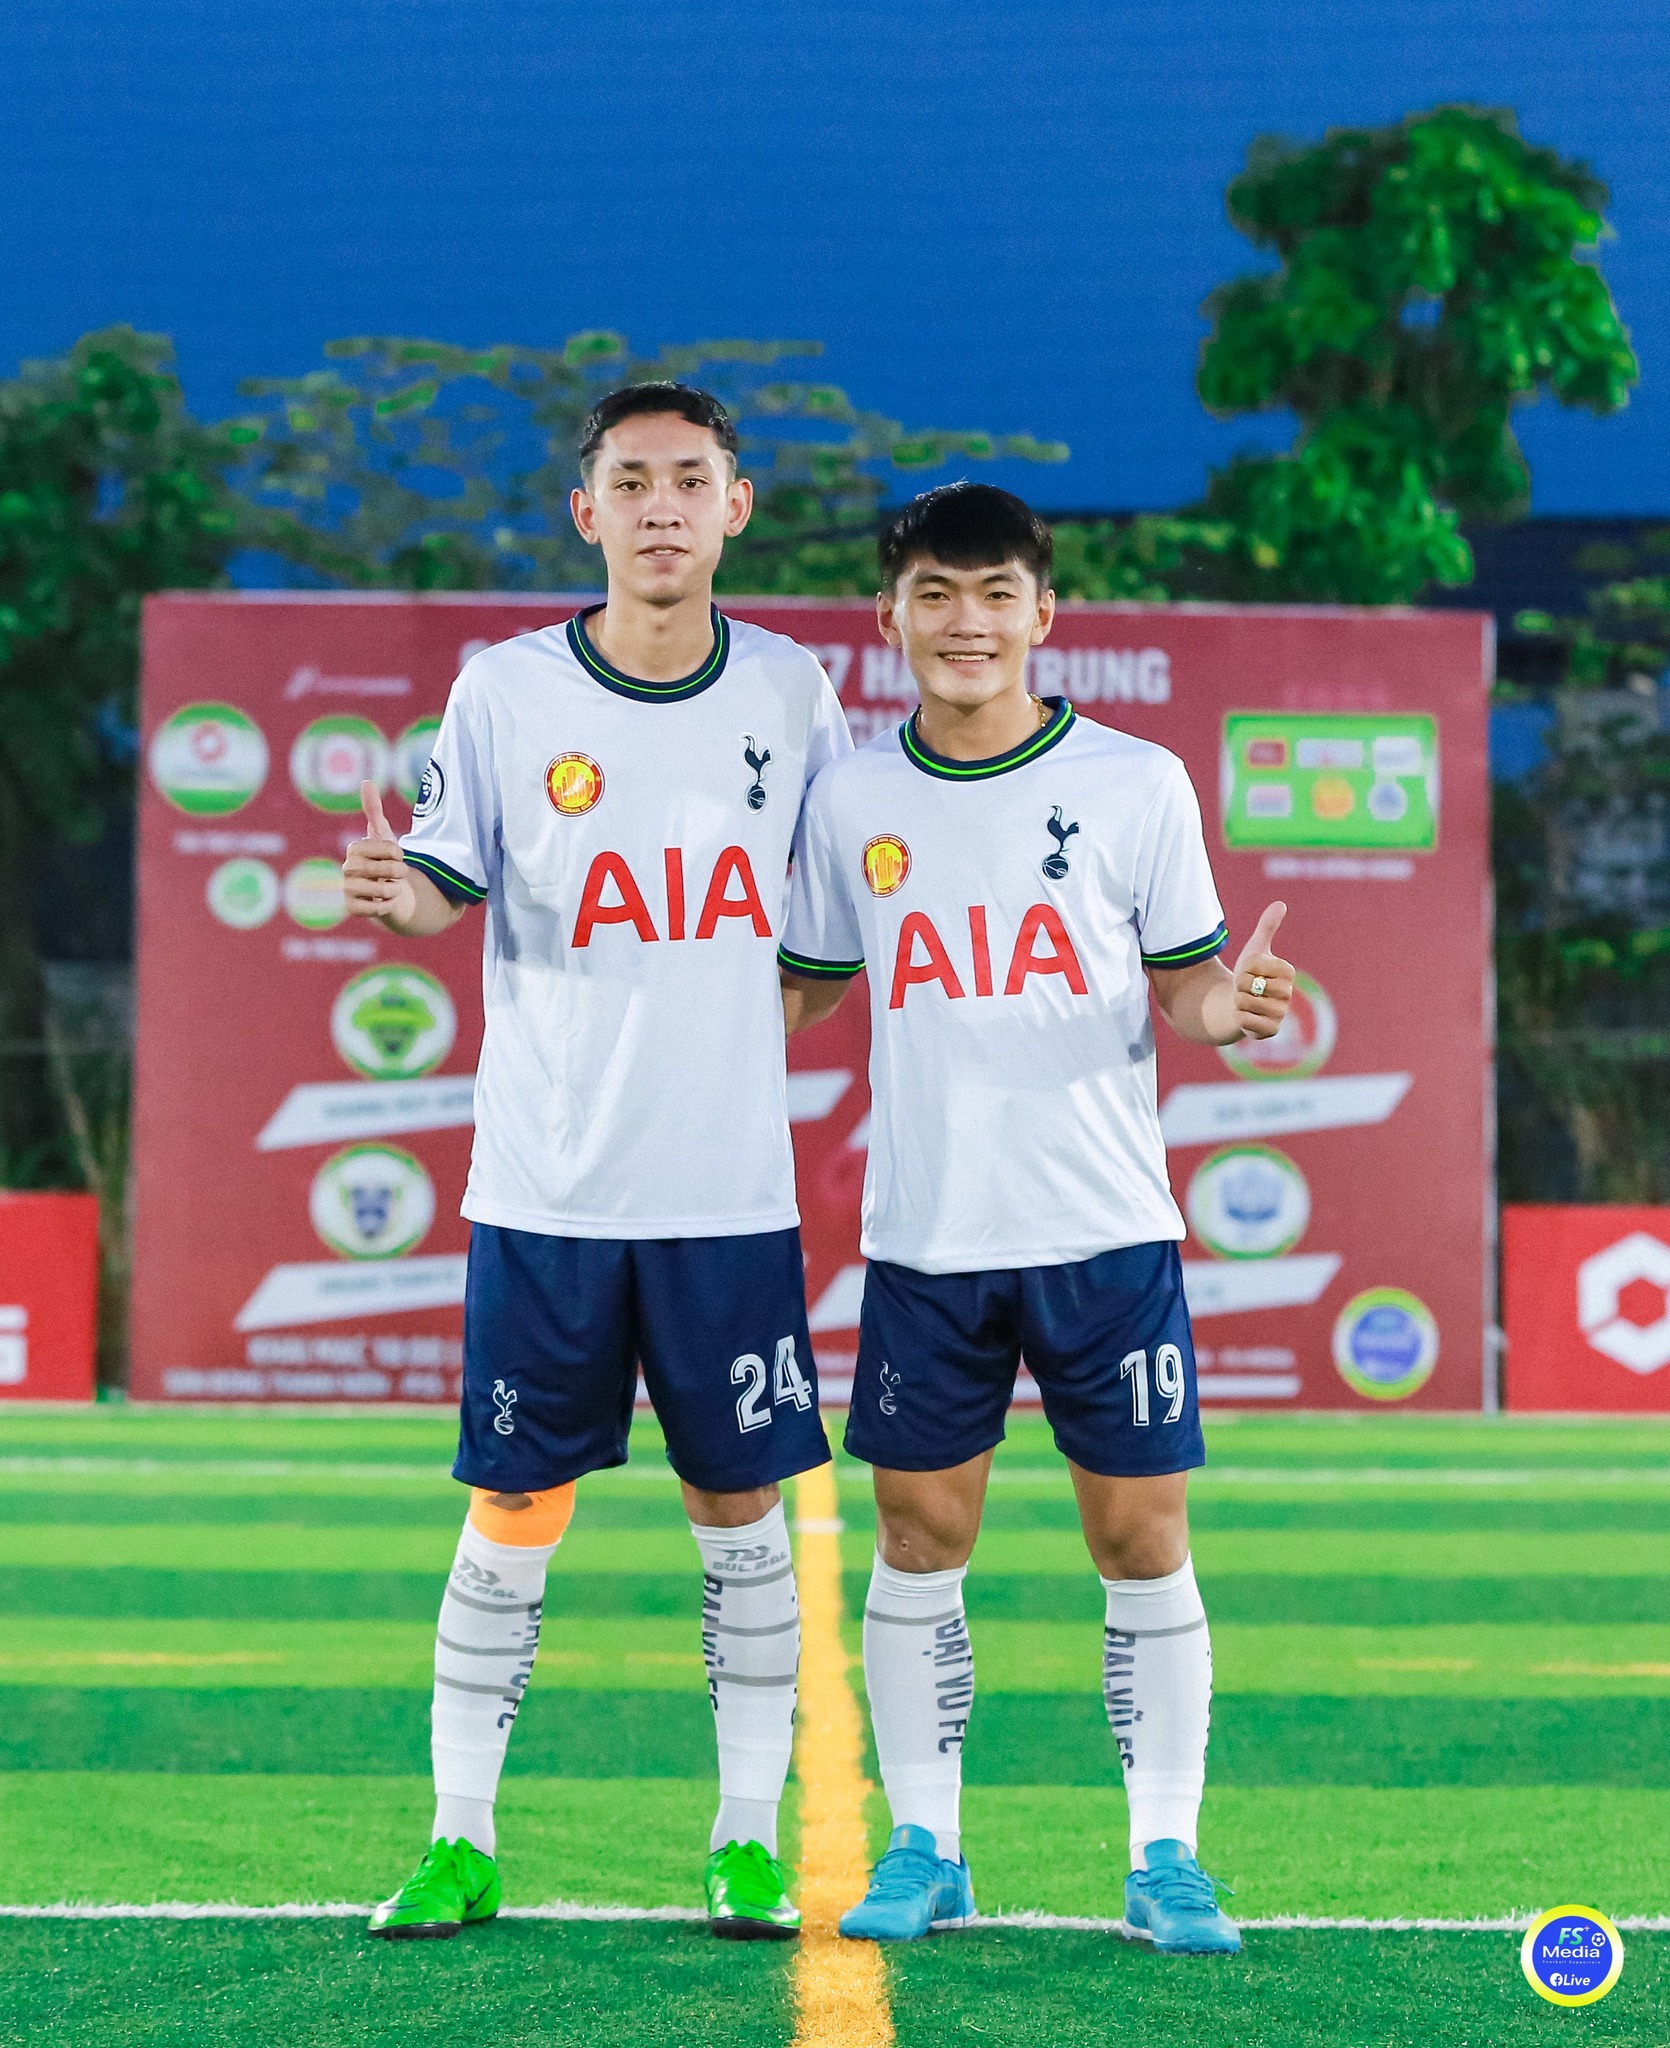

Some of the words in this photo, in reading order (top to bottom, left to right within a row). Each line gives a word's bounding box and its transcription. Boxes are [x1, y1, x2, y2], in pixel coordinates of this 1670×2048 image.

[571, 845, 773, 948] AIA
[889, 903, 1088, 1009] AIA
[730, 1334, 813, 1433] 24
[1120, 1343, 1185, 1426] 19
[938, 1719, 967, 1753] FC
